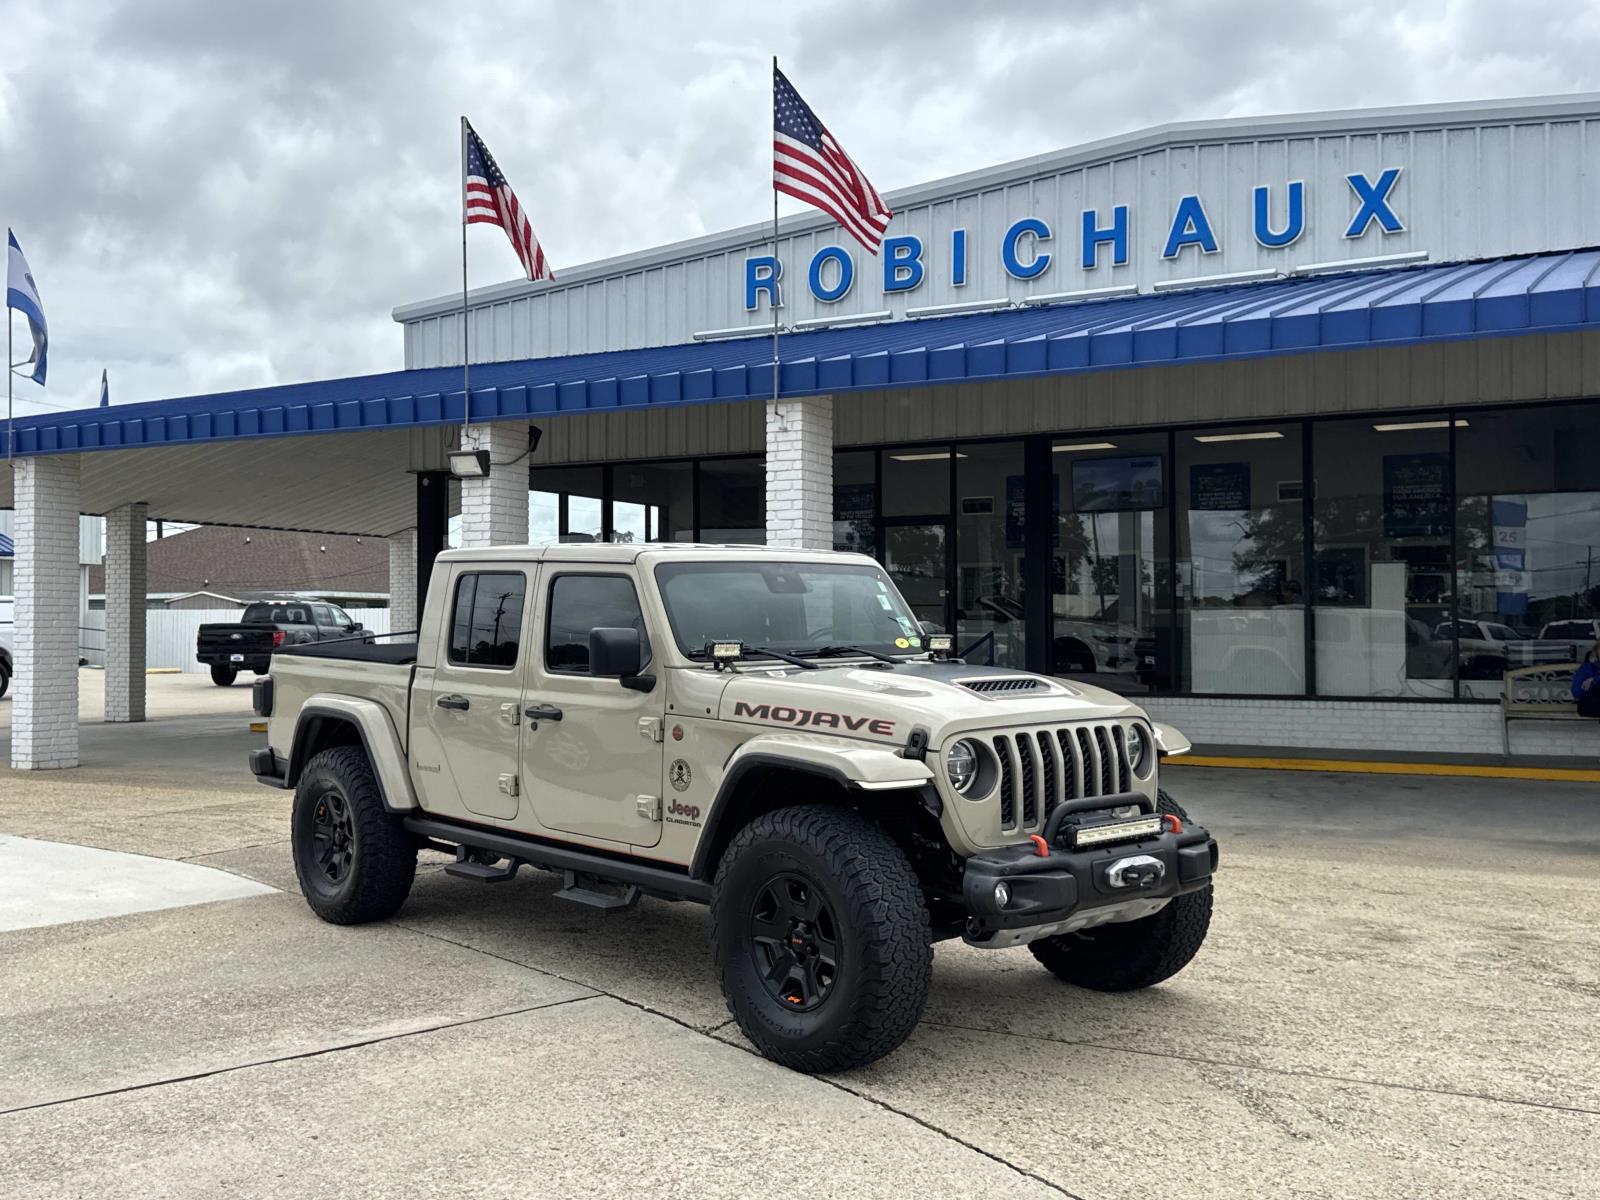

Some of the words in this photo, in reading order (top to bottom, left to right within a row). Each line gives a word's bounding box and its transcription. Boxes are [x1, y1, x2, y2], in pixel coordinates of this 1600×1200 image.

[745, 167, 1407, 311] ROBICHAUX
[733, 701, 896, 737] MOJAVE
[667, 798, 701, 821] Jeep
